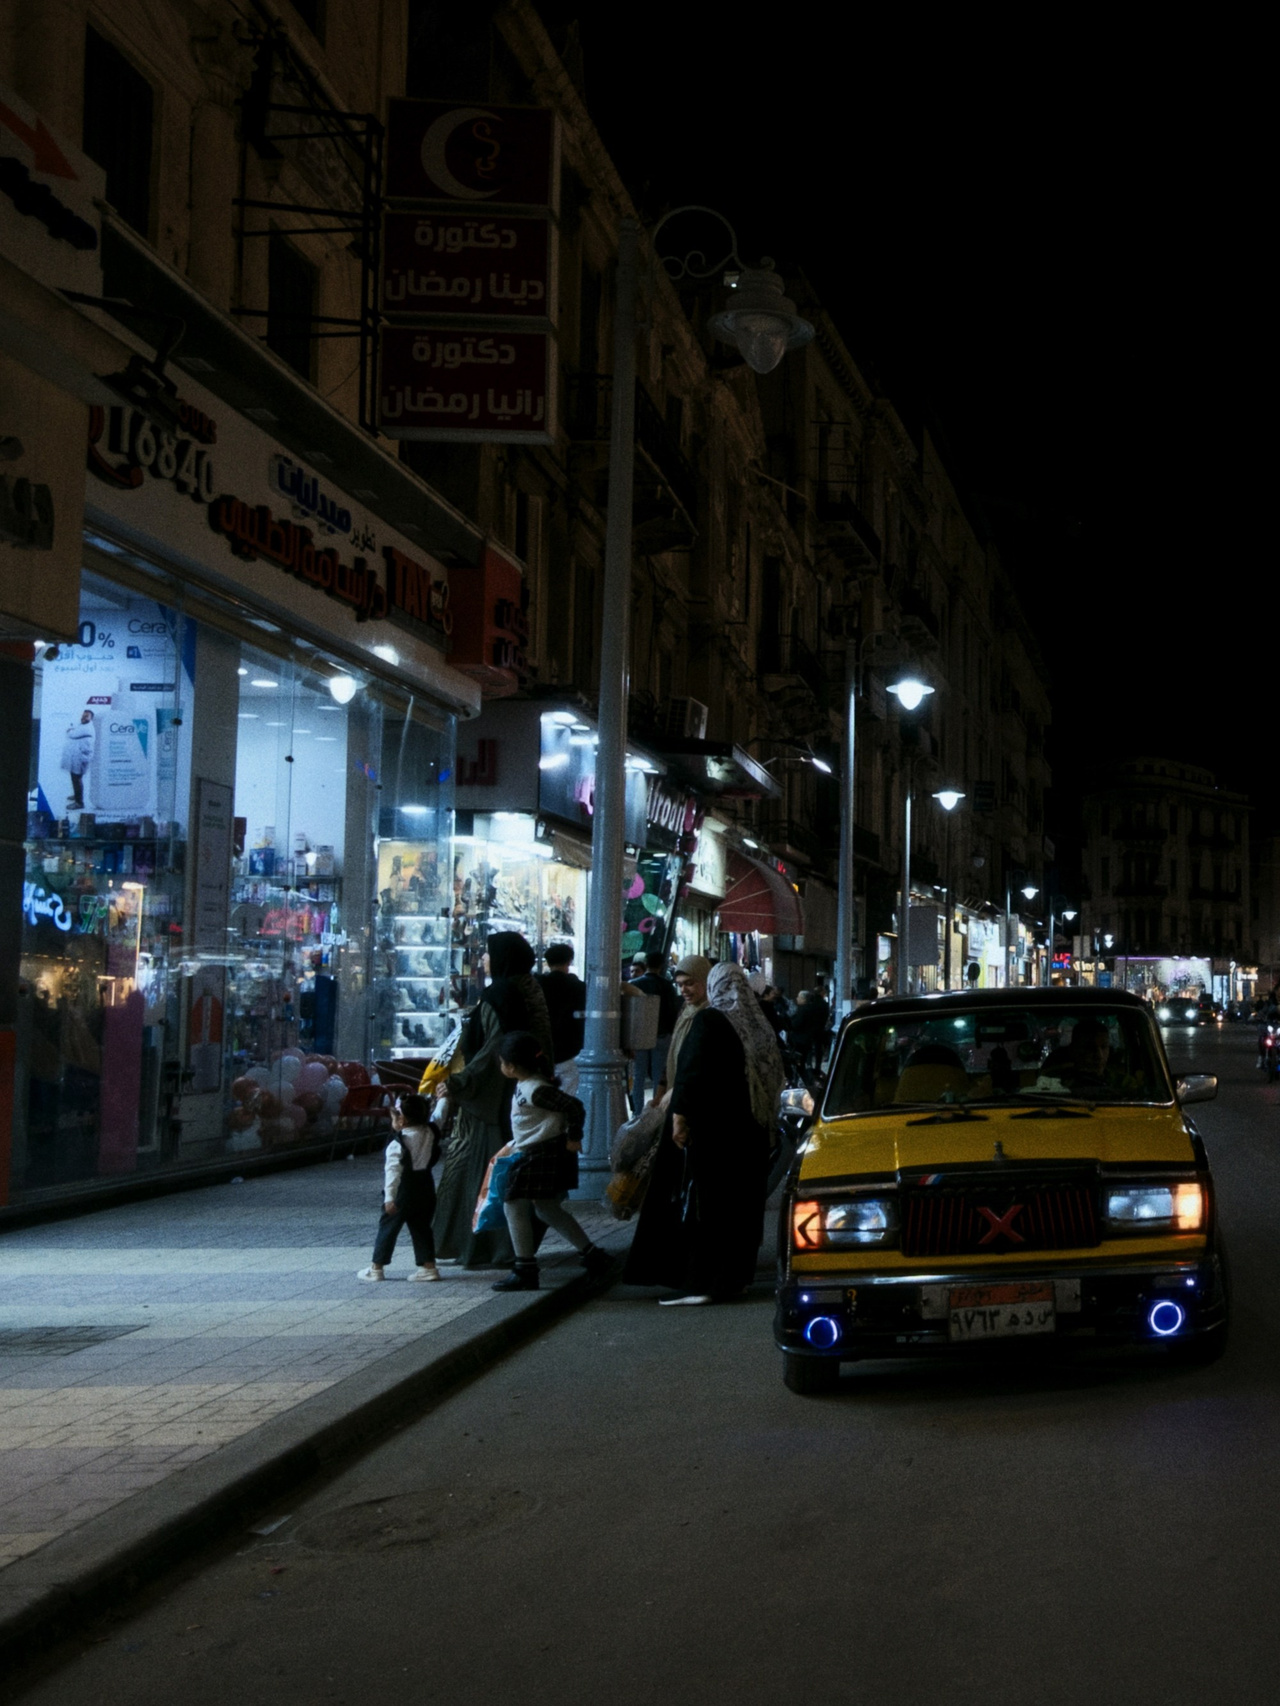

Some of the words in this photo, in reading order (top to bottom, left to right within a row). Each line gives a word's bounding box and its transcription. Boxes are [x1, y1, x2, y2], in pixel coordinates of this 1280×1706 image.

[414, 220, 518, 253] دكتورة
[385, 268, 483, 304] رمضان
[489, 271, 546, 306] دينا
[412, 335, 516, 370] دكتورة
[382, 384, 481, 419] رمضان
[487, 387, 546, 421] رانيا
